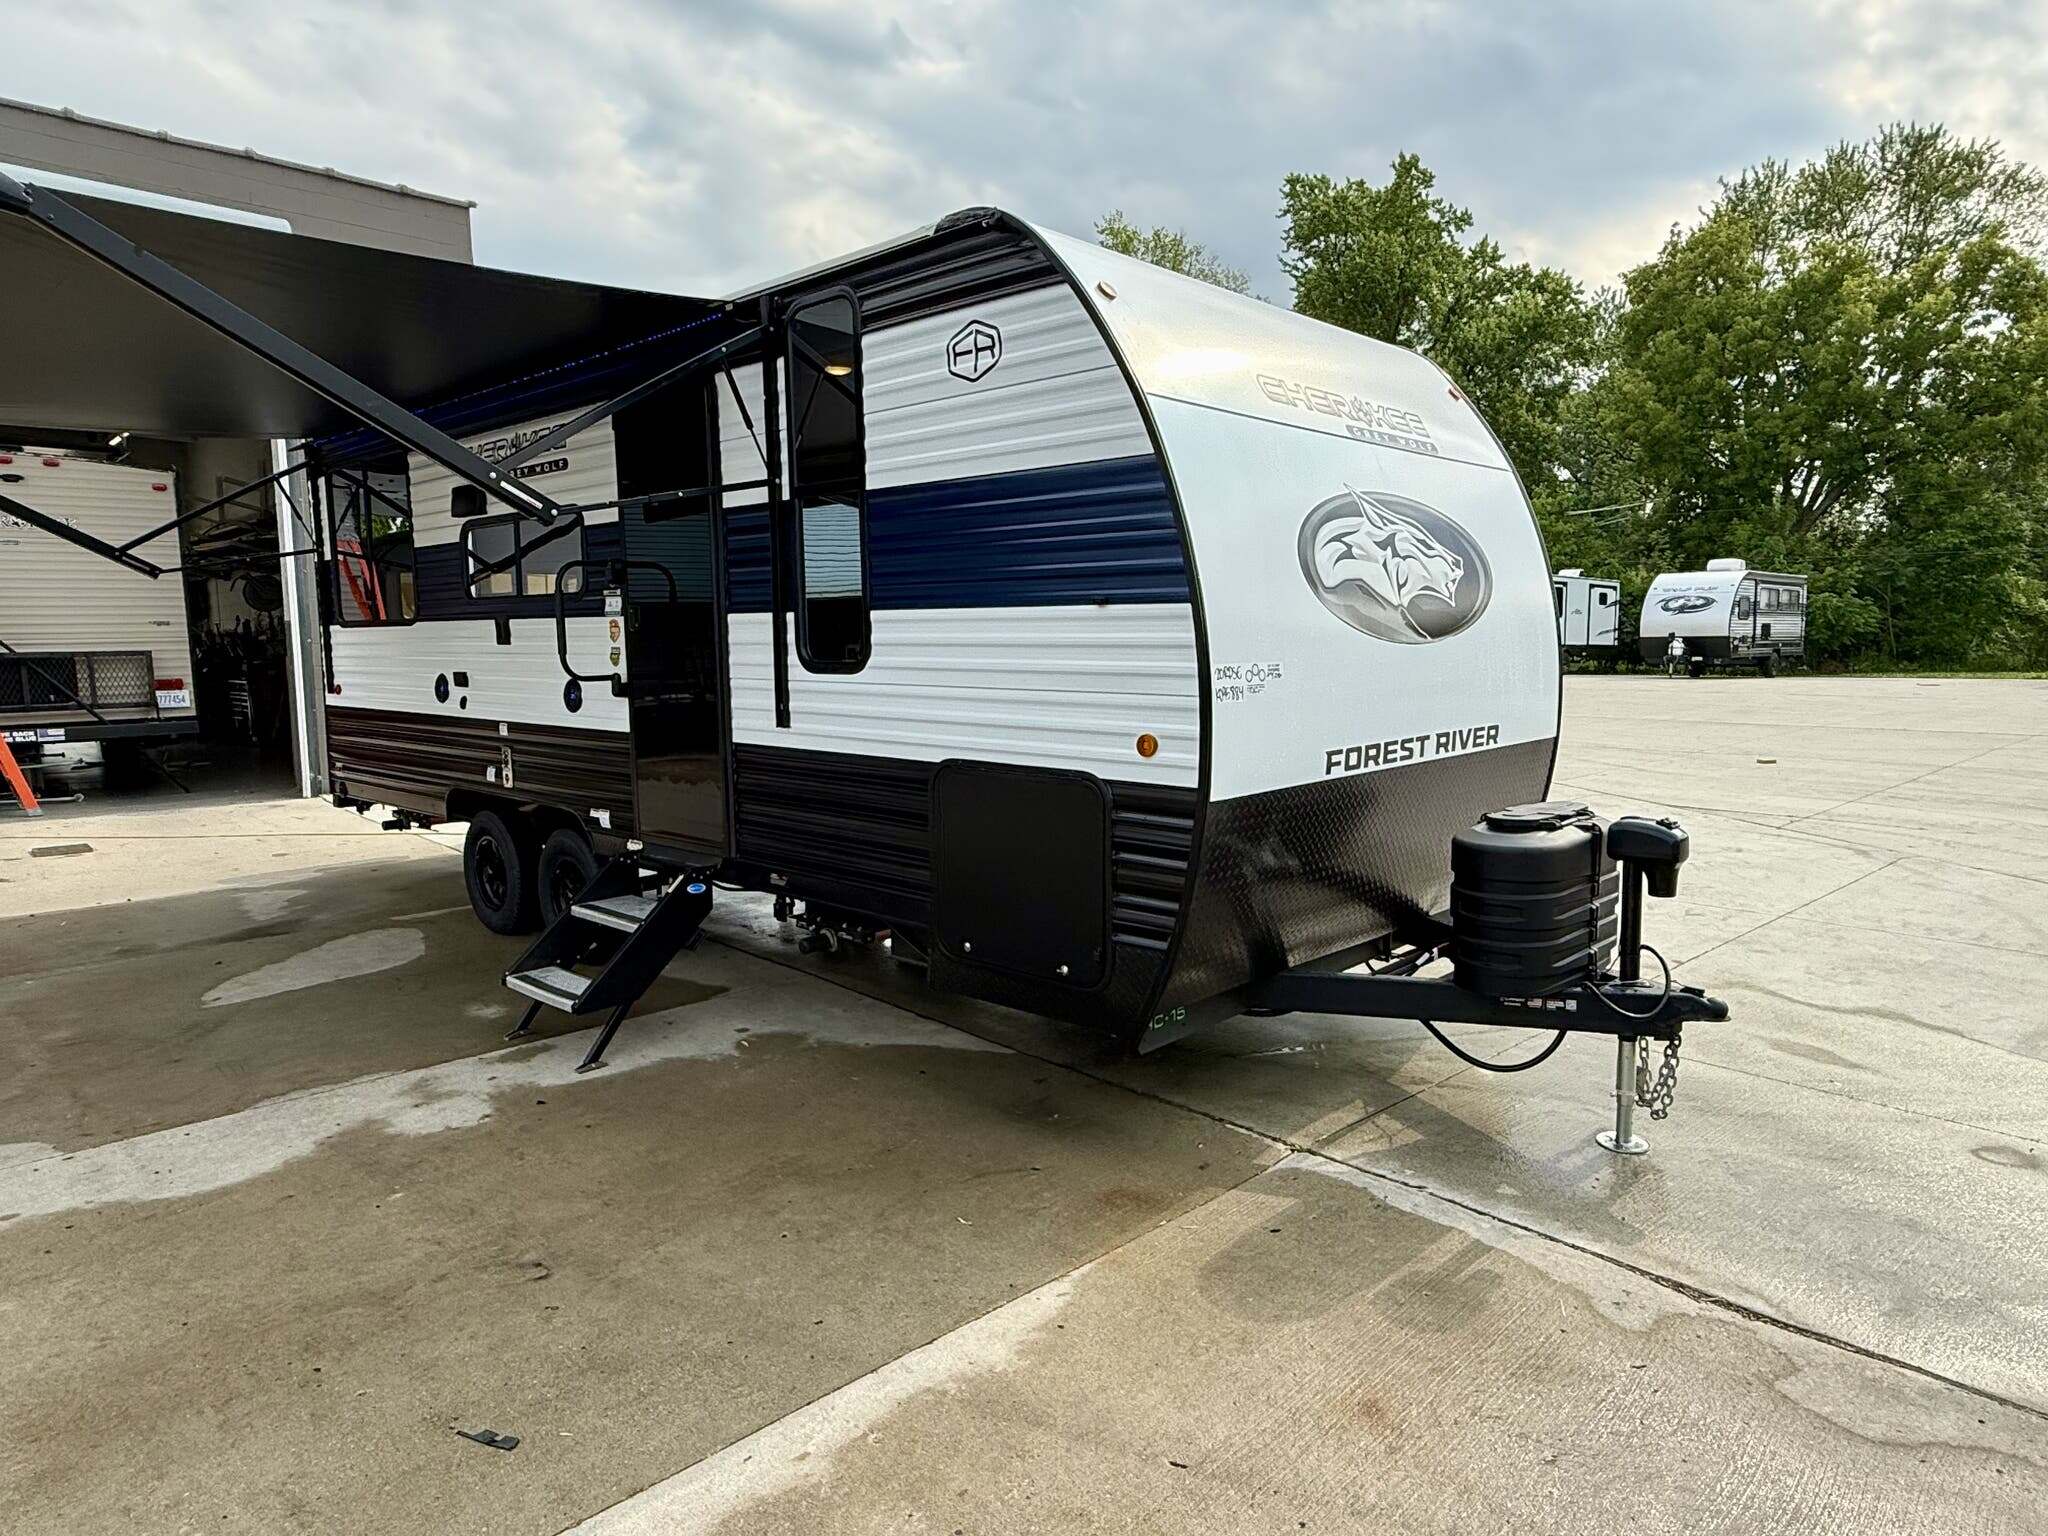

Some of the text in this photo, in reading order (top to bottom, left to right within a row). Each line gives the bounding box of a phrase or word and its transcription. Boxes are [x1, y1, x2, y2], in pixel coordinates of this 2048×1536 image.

[1256, 373, 1431, 439] CHEROKEE
[1352, 426, 1433, 452] GREY WOLF
[511, 461, 565, 478] REY WOLF
[1325, 724, 1500, 776] FOREST RIVER
